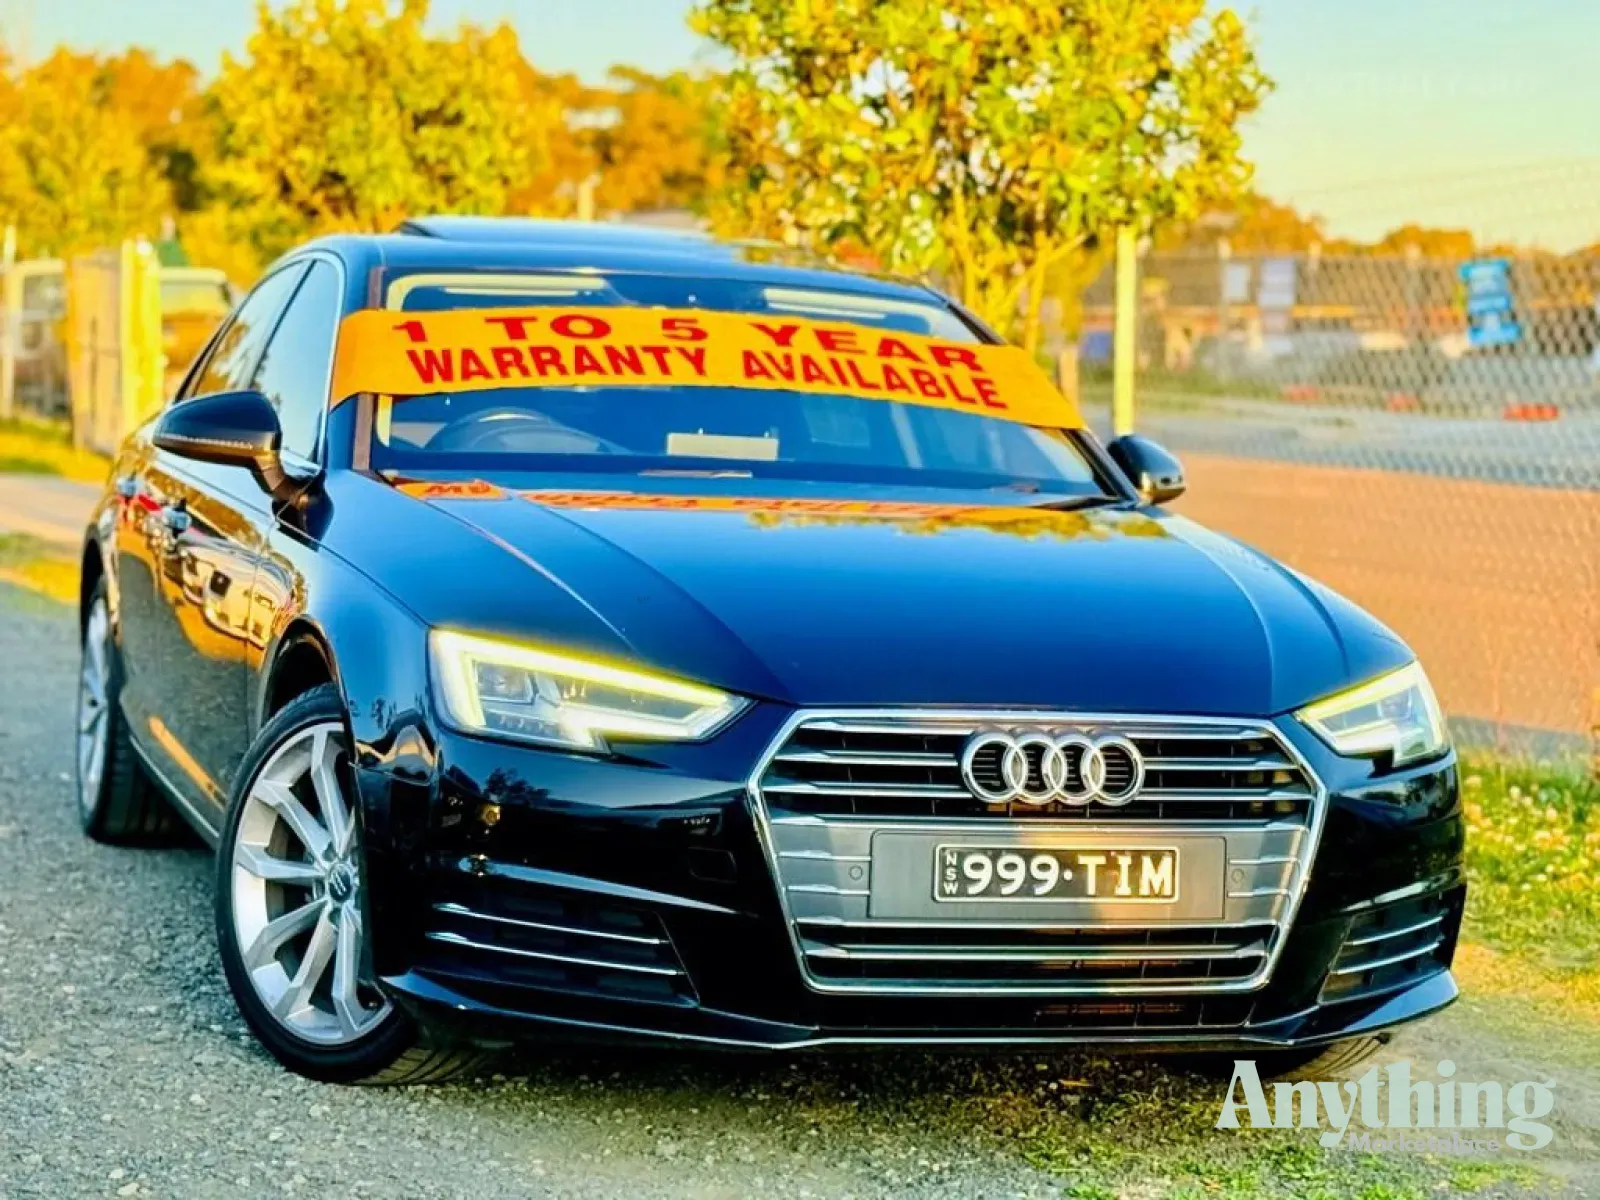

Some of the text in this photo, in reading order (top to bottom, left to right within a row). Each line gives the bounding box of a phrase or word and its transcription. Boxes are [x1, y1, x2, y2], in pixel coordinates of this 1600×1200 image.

[392, 314, 985, 372] 1 TO 5 YEAR
[406, 344, 1009, 410] WARRANTY AVAILABLE
[942, 853, 959, 895] NSW
